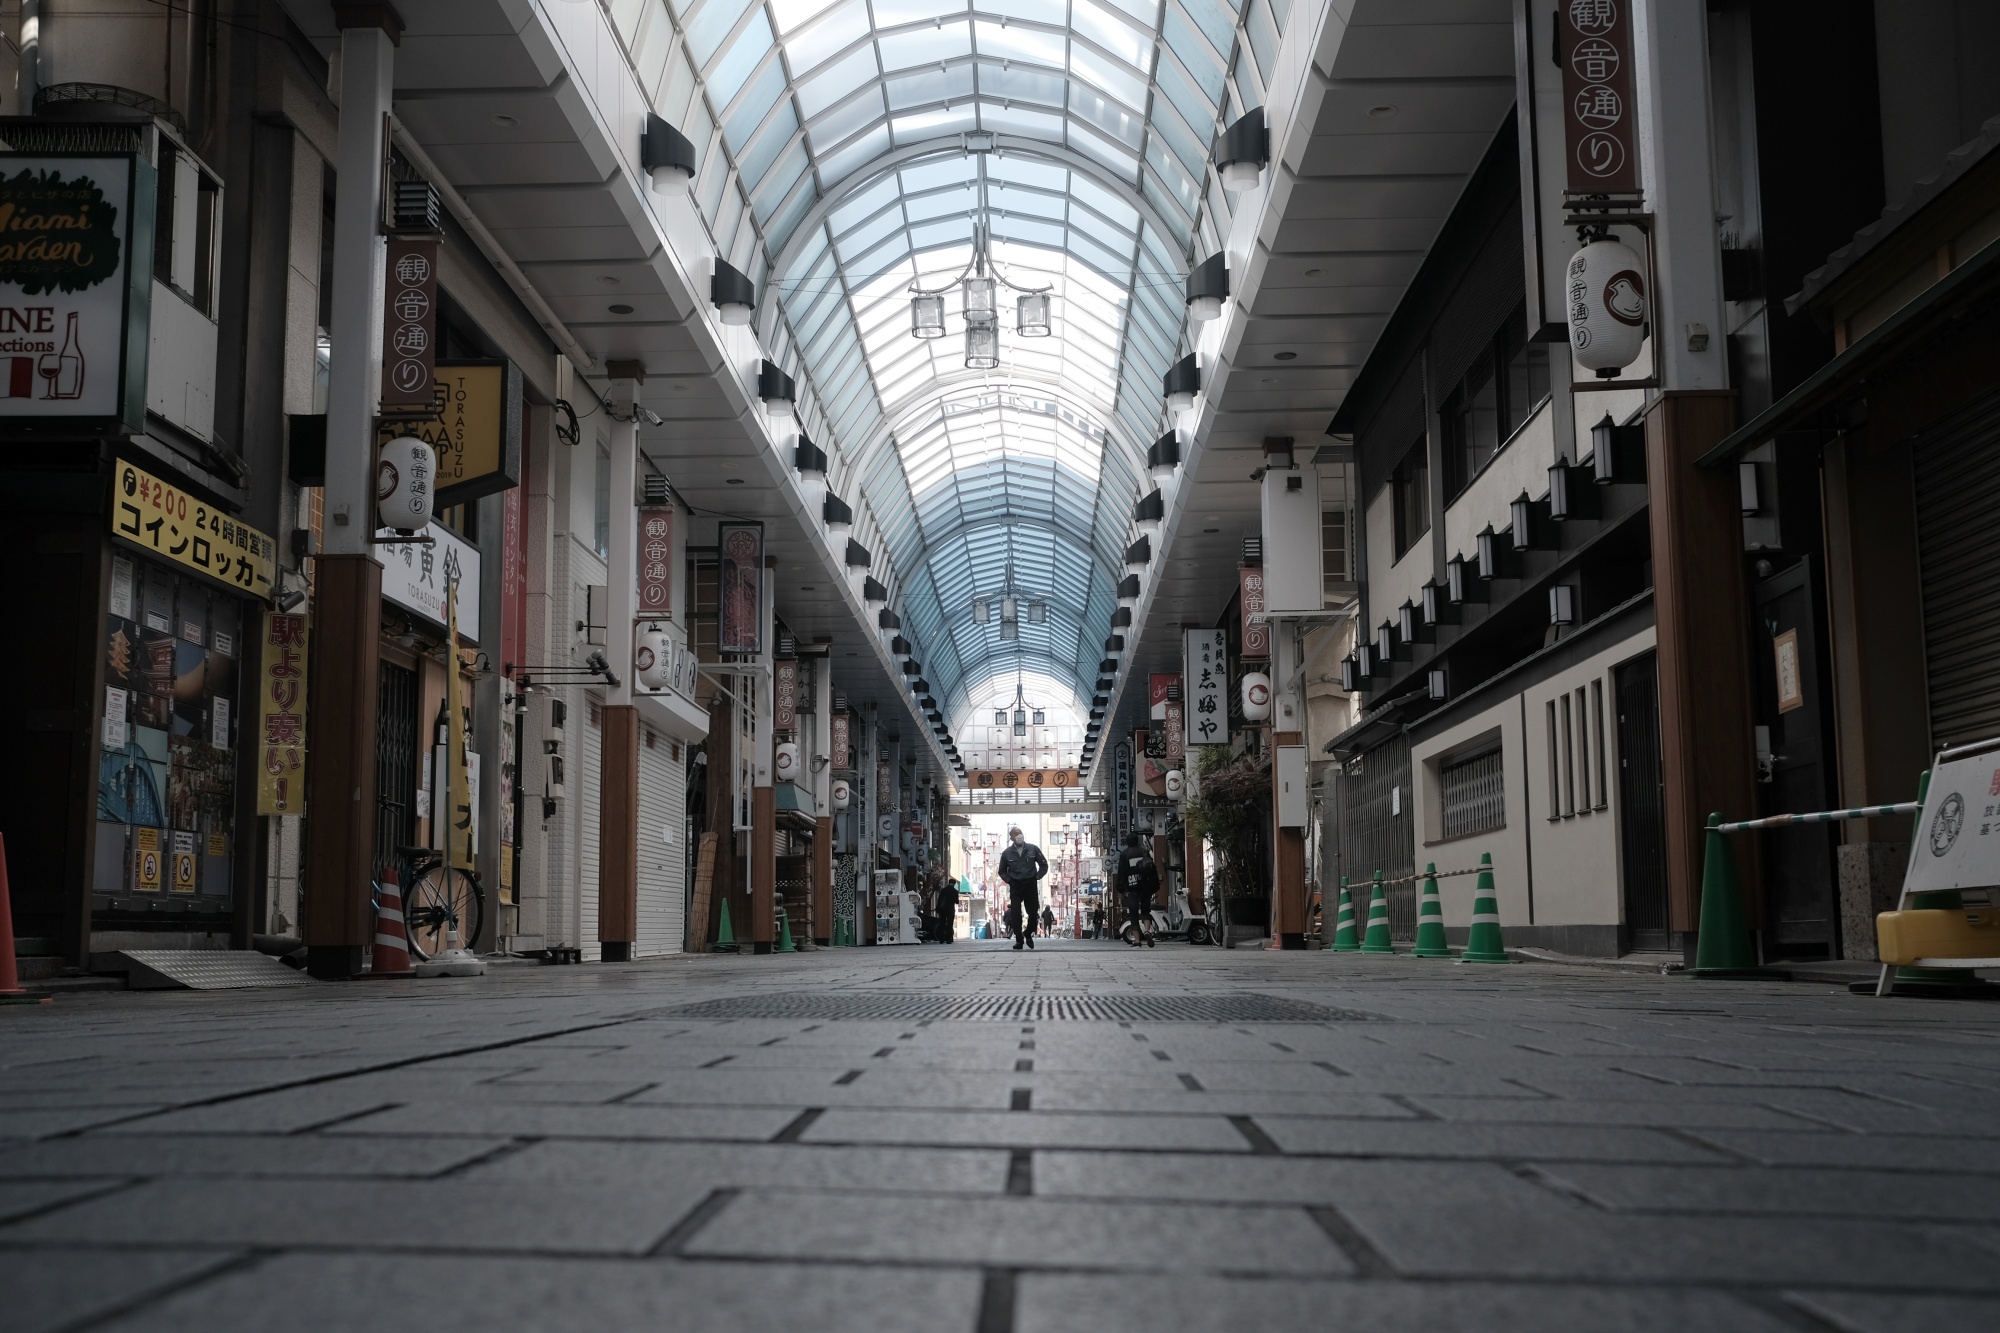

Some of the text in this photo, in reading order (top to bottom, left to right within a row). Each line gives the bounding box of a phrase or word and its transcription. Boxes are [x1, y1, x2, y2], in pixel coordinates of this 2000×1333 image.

[1569, 0, 1624, 177] 観音通り
[393, 254, 430, 392] 観音通り
[1570, 256, 1591, 349] 観音通り
[455, 377, 466, 478] TORASUZU
[409, 446, 428, 514] 観音通り
[120, 501, 272, 587] コインロッカー
[196, 507, 272, 562] 24時間営業
[644, 518, 667, 605] 観音通り
[408, 583, 440, 611] TORASUZU
[778, 666, 794, 725] 観音通り
[834, 718, 847, 766] 観音通り
[1168, 708, 1181, 756] 観音通り
[978, 771, 1069, 788] 観音通り
